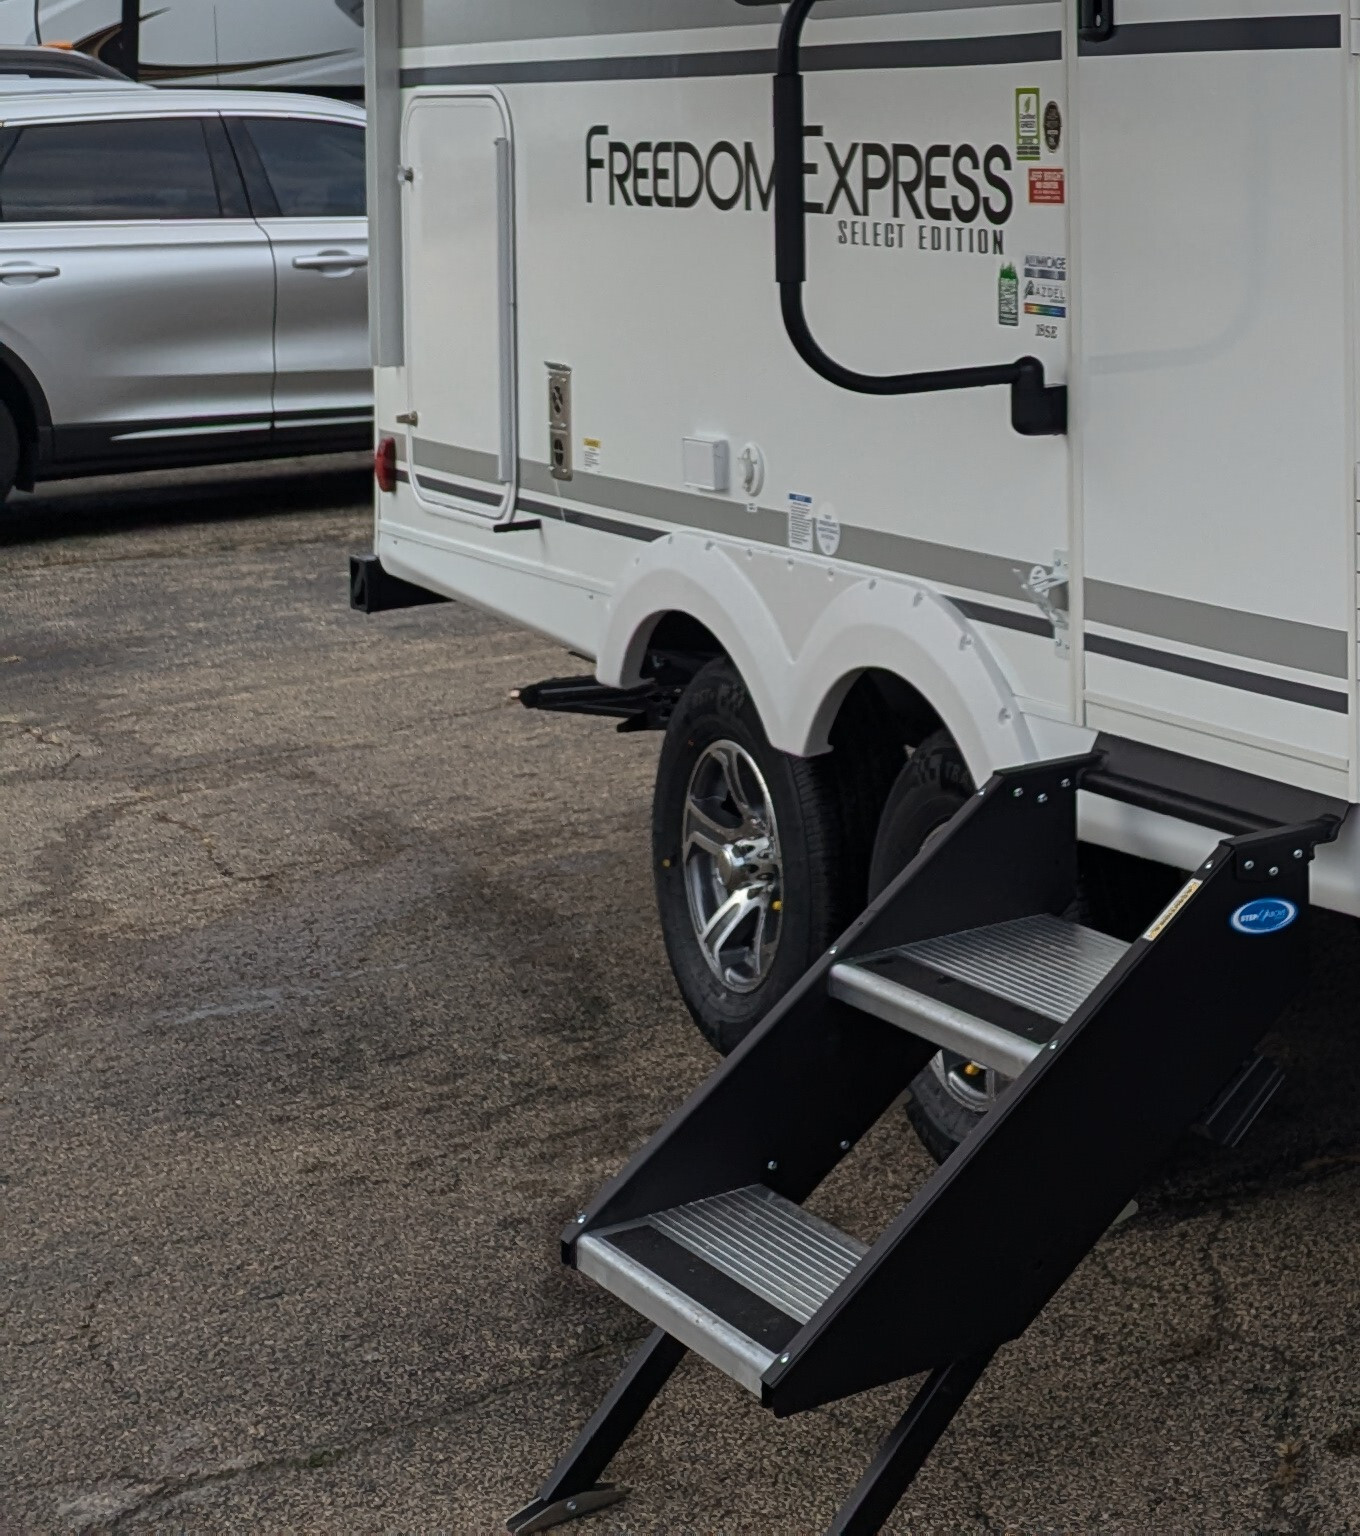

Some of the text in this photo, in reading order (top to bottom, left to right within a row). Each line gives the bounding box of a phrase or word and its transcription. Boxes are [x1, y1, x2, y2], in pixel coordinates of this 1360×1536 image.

[802, 125, 1013, 225] EXPRESS
[838, 220, 1004, 255] SELECT EDITION
